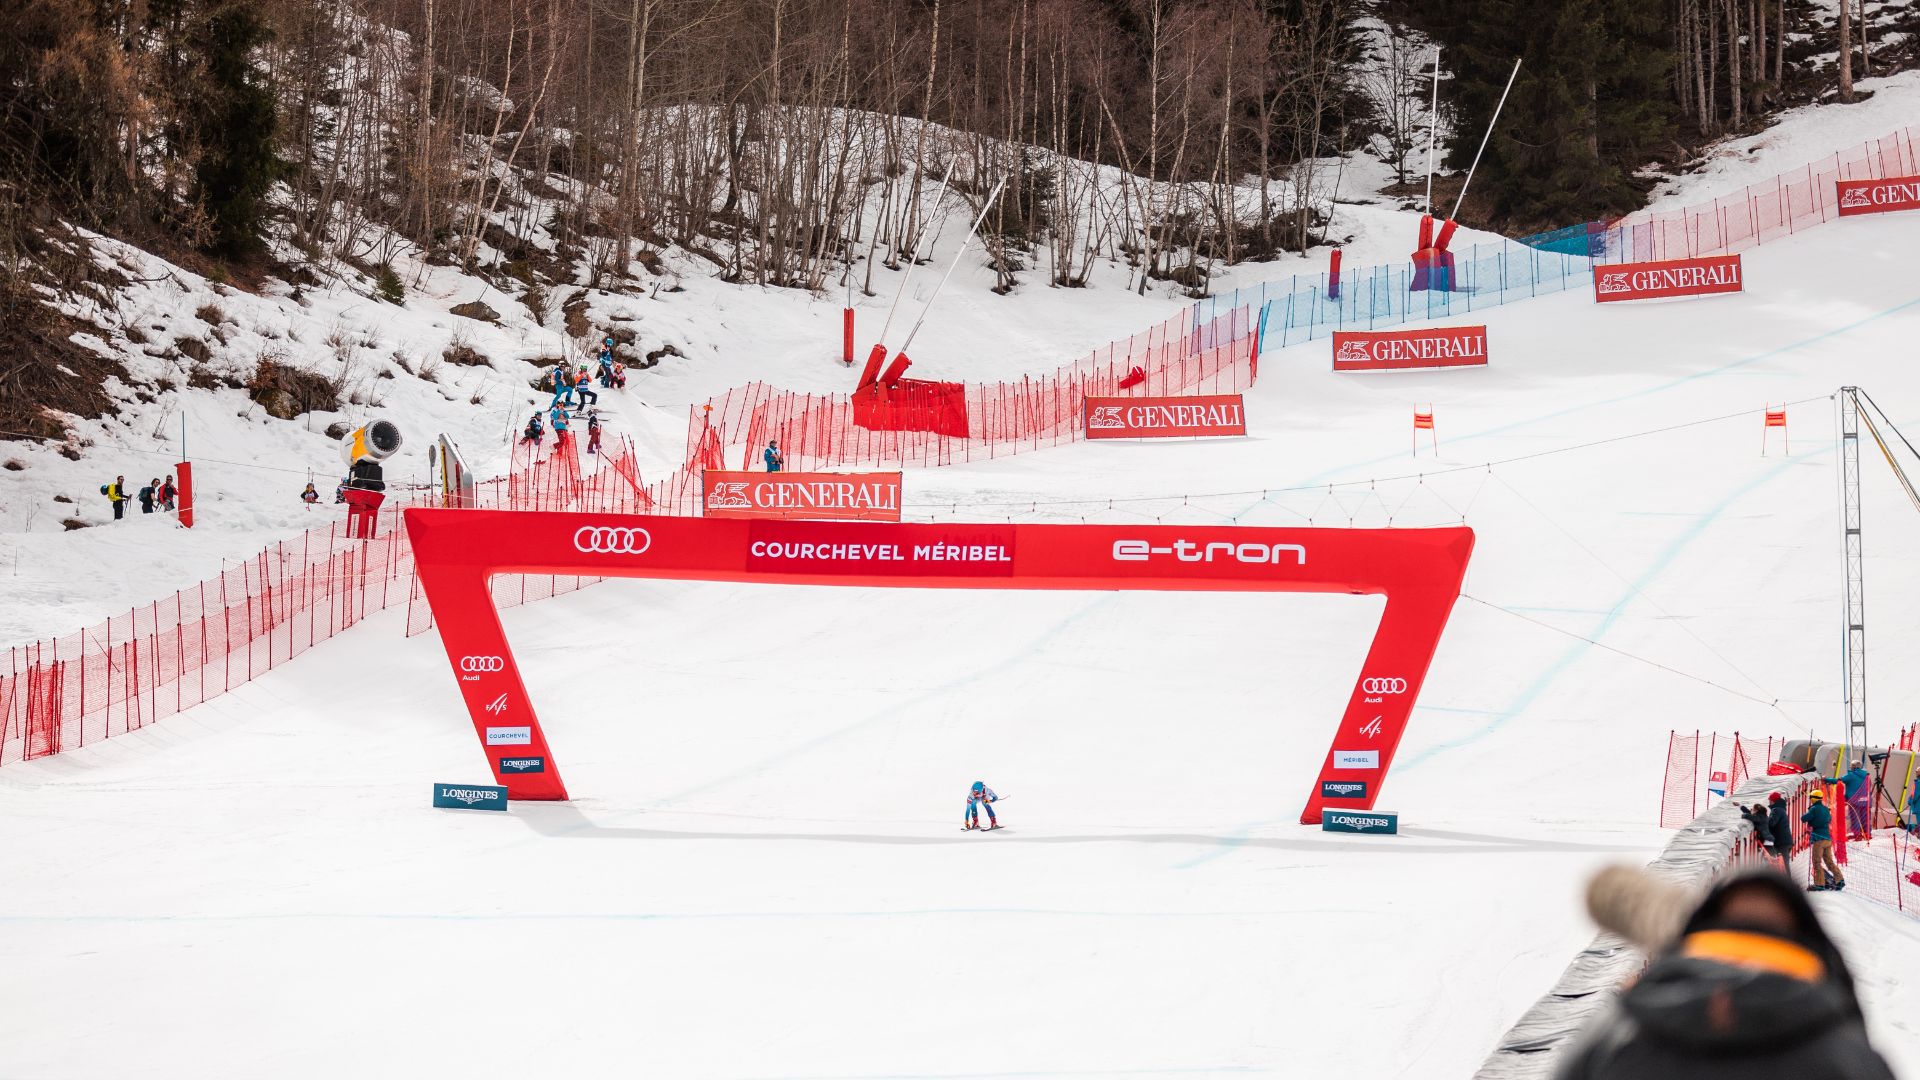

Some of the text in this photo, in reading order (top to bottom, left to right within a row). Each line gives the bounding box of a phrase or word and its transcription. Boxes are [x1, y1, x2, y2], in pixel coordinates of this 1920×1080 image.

[1872, 183, 1920, 205] GEN
[1632, 264, 1739, 291] GENERALI
[1372, 335, 1484, 361] GENERALI
[1127, 404, 1242, 428] GENERALI
[754, 482, 898, 510] GENERALI
[751, 541, 1011, 562] COURCHEVEL MÉRIBEL
[1113, 539, 1306, 565] e-tron
[503, 759, 540, 767] LONGINES
[442, 788, 499, 800] LONGINES
[1325, 783, 1362, 791] LONGINES
[1331, 815, 1389, 827] LONGINES
